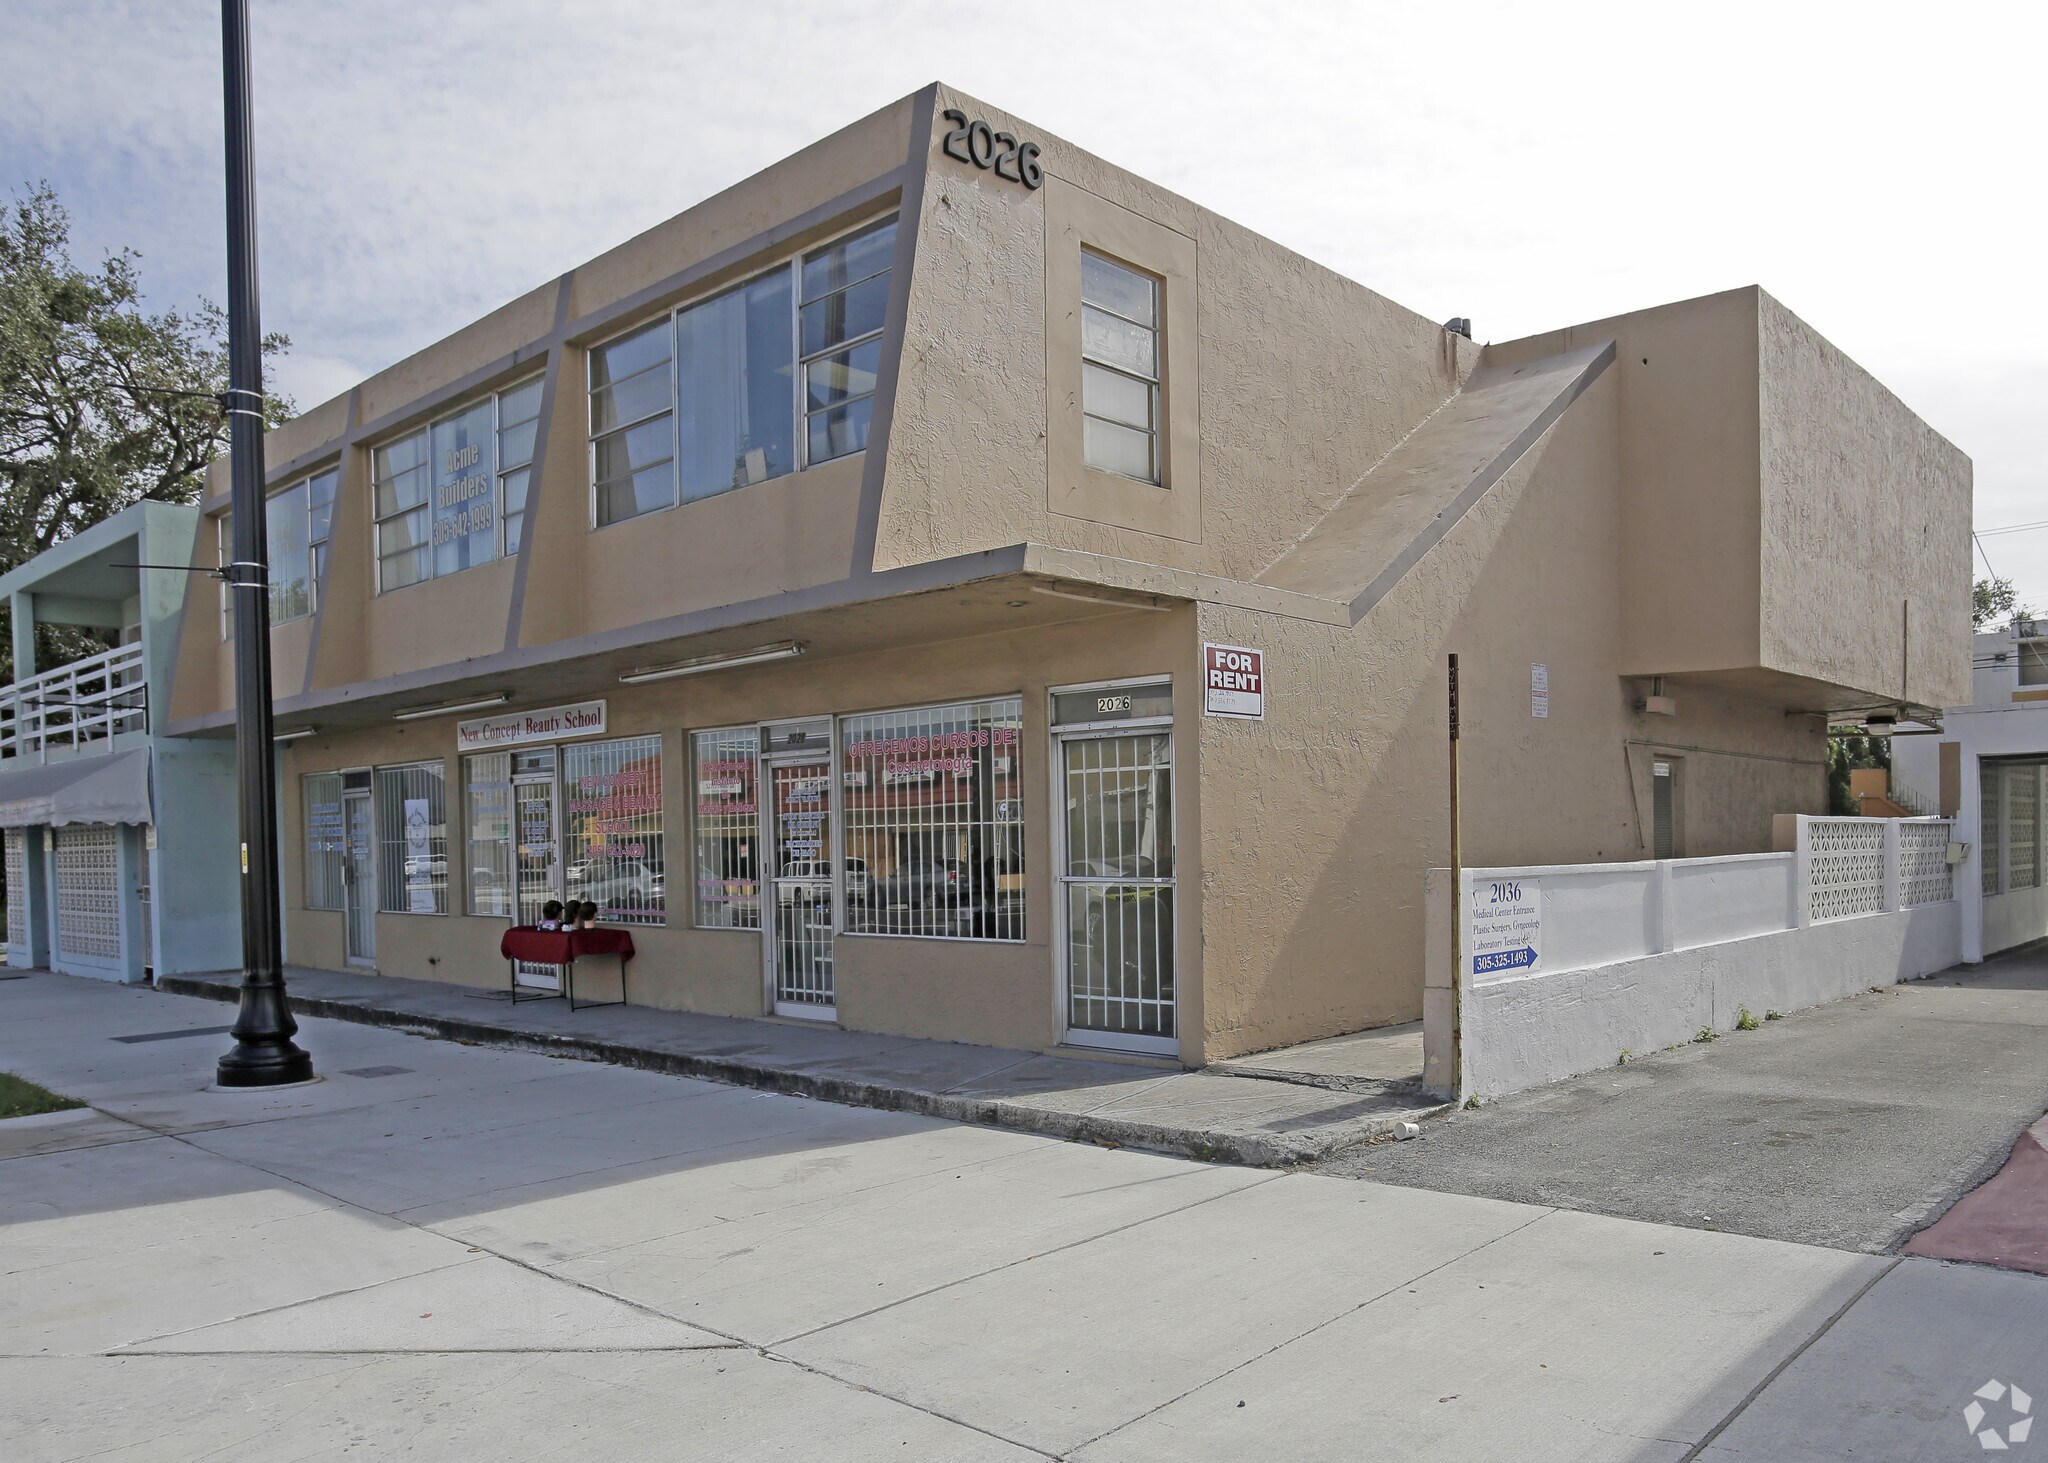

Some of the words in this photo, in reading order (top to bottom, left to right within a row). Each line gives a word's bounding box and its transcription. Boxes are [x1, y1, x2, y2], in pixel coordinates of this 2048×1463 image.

[943, 109, 1043, 190] 2026
[446, 444, 479, 475] Acme
[438, 473, 487, 510] Builders
[433, 502, 492, 546] 305-642-1999
[1215, 651, 1252, 672] FOR
[1210, 669, 1259, 691] RENT
[1098, 696, 1130, 712] 2026
[460, 727, 479, 743] New
[483, 722, 520, 741] Concept
[526, 716, 561, 734] Beauty
[565, 707, 601, 729] School
[849, 735, 928, 758] OFRECEMOS
[931, 730, 988, 751] CURSOS
[992, 729, 1018, 746] DE:
[888, 753, 973, 774] Cosmetología
[580, 774, 600, 789] NEW
[602, 771, 647, 787] CONCEPT
[568, 796, 613, 812] MASSAGE
[622, 794, 662, 810] BEAUTY
[595, 819, 634, 834] SCHOOL
[1490, 882, 1522, 903] 2036
[1472, 908, 1494, 919] Medical
[1494, 906, 1512, 917] Center
[1512, 905, 1535, 916] Entrance
[1473, 924, 1490, 935] Plastic
[1512, 919, 1540, 931] Gynecology
[1473, 939, 1502, 950] Laboratory
[1503, 937, 1521, 946] Testing
[1477, 950, 1528, 970] 305-325-1493
